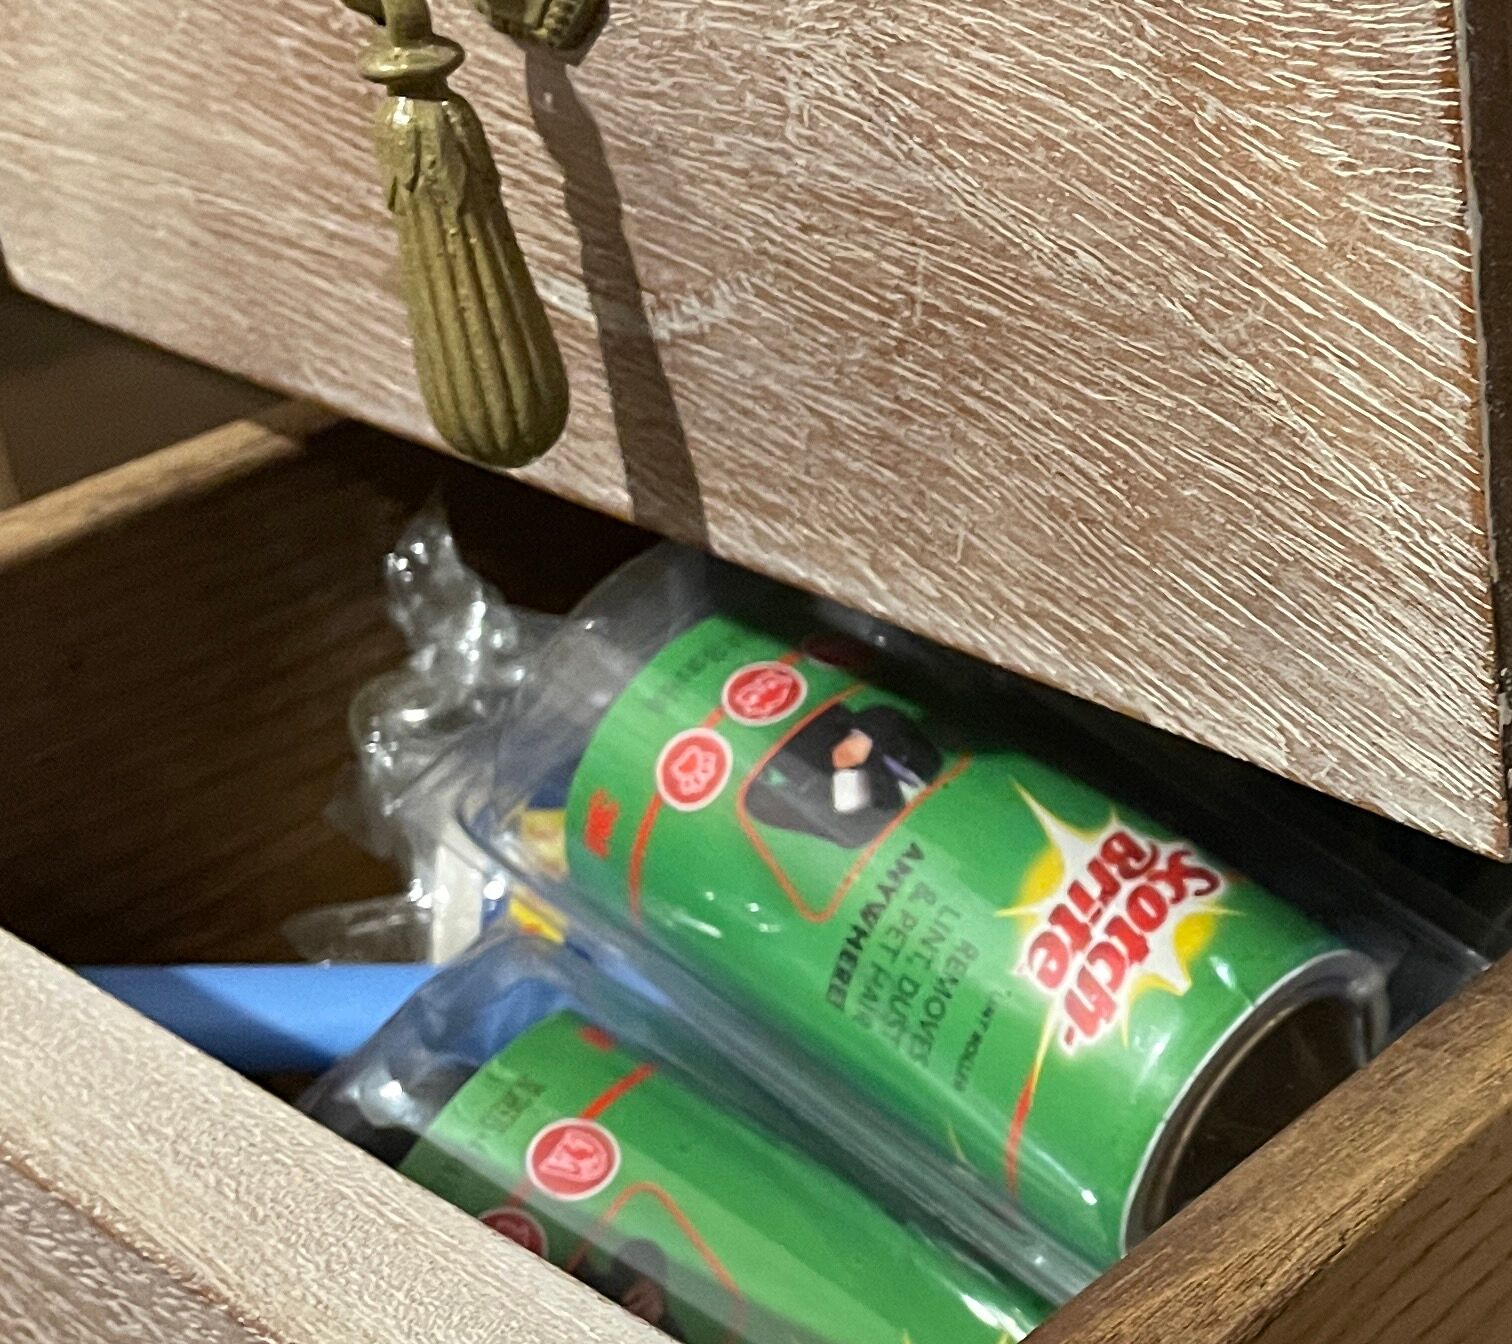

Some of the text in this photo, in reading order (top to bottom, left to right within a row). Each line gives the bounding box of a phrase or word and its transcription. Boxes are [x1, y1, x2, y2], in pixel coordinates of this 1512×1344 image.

[879, 908, 920, 965] PET
[1027, 830, 1161, 989] Brite
[852, 960, 896, 1032] HAIR
[882, 974, 922, 1044] DUST
[910, 938, 981, 1068] REMOVES
